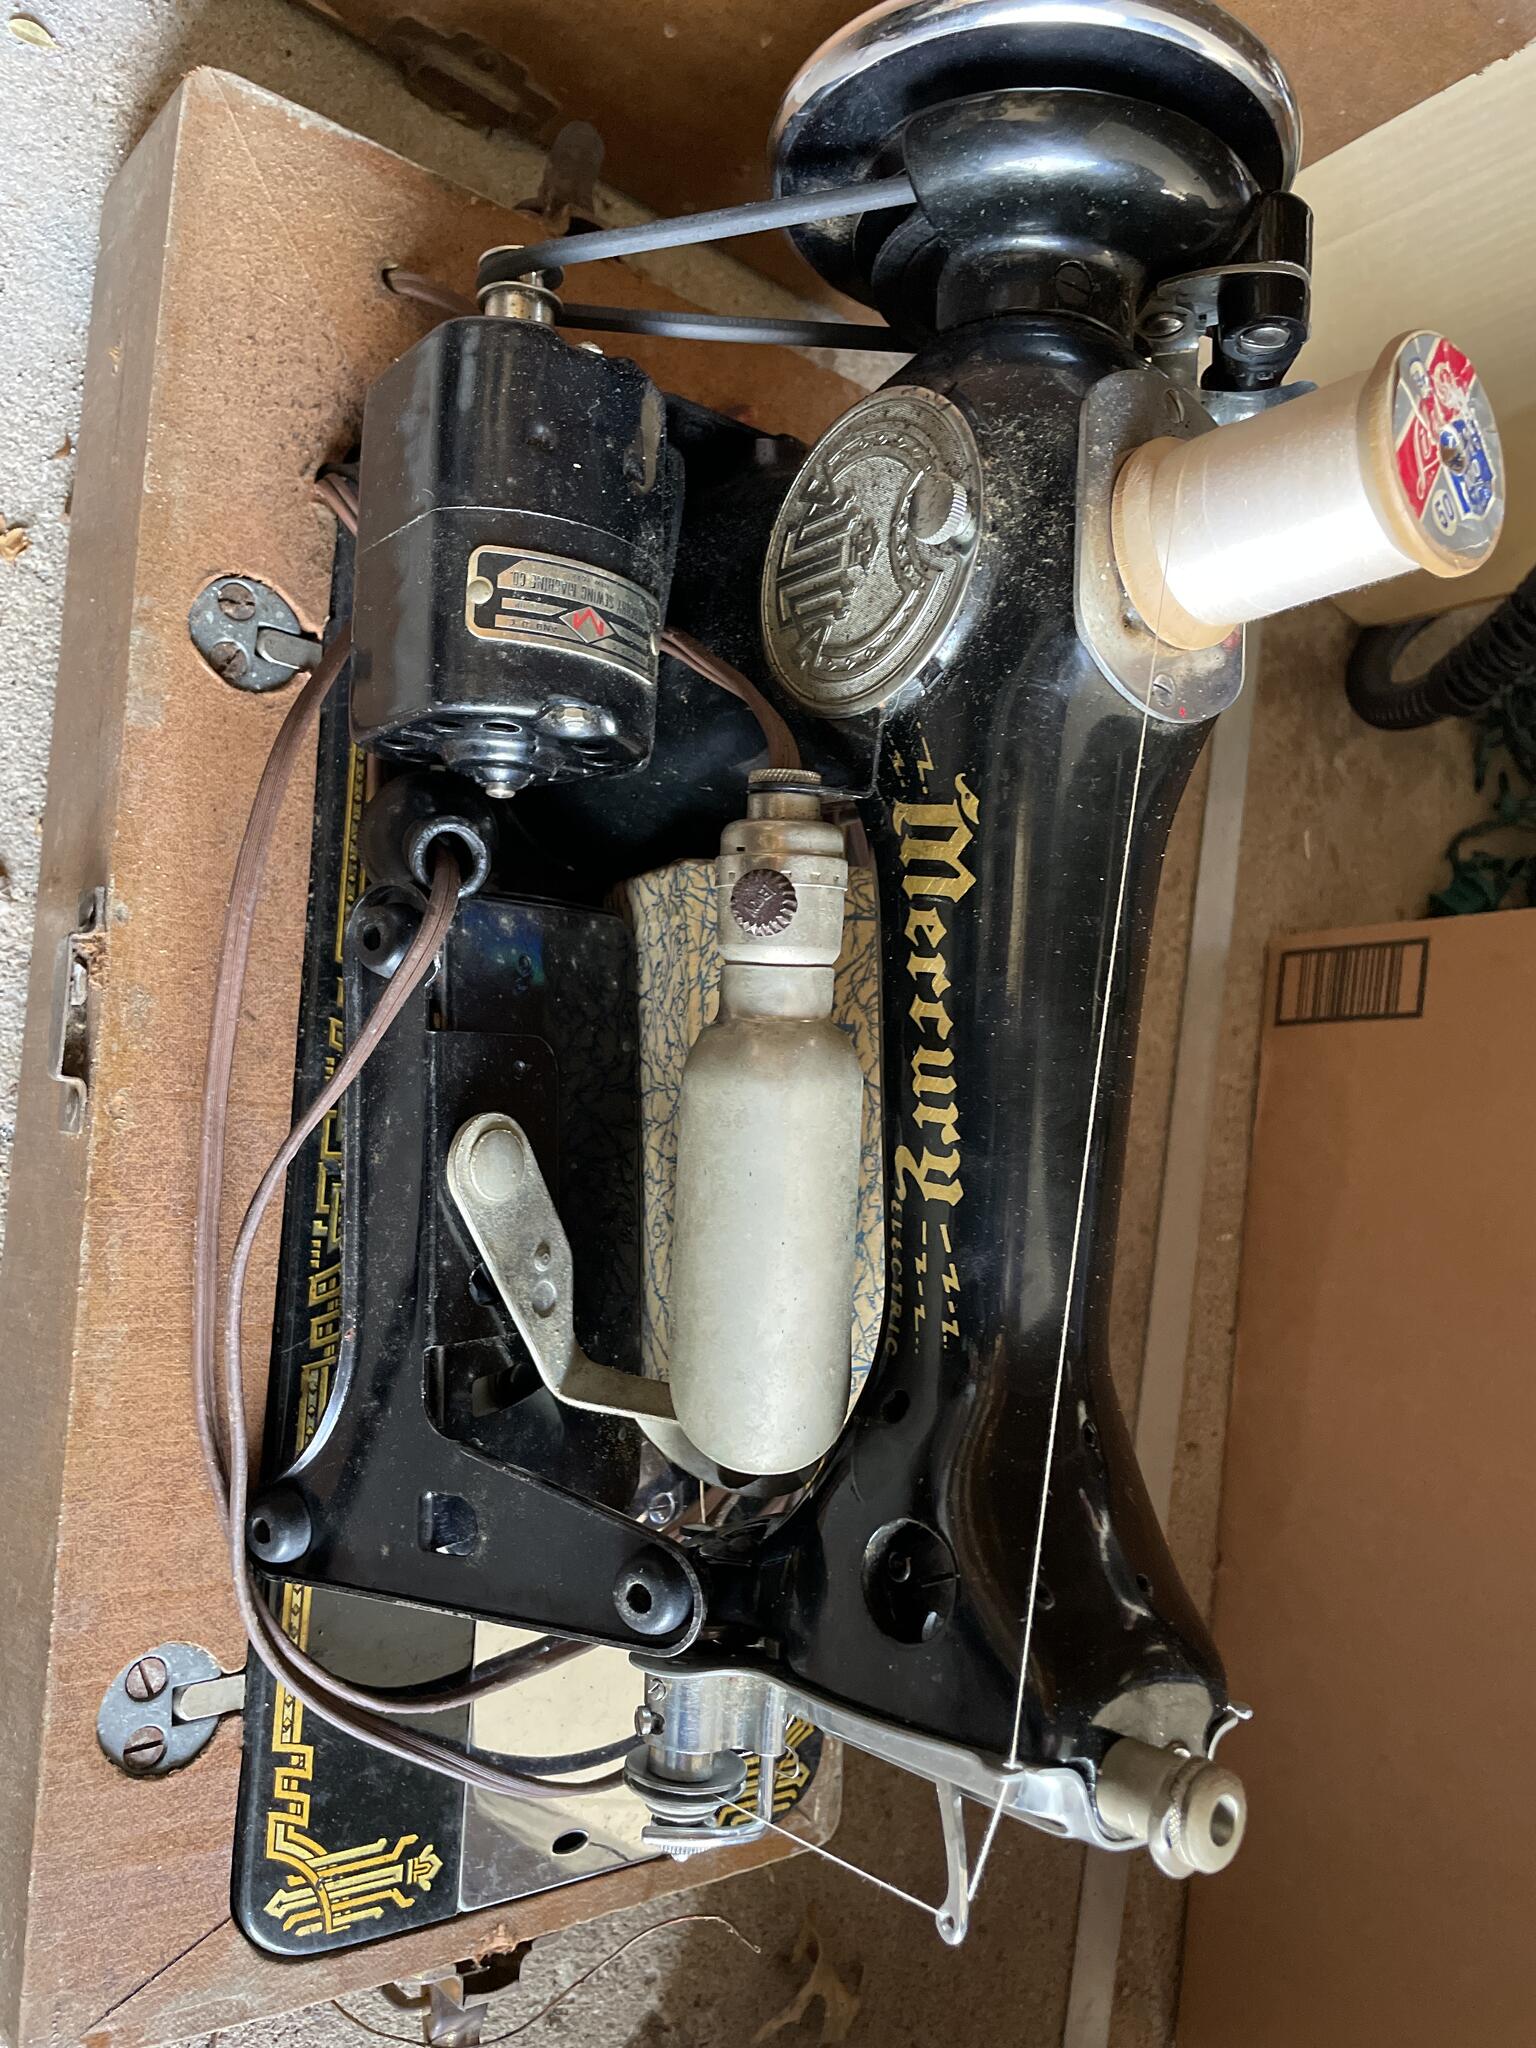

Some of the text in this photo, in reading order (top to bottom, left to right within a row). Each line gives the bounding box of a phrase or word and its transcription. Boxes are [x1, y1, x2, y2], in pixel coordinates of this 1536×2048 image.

[1434, 492, 1455, 529] 50
[531, 573, 578, 599] MACHINE
[581, 586, 615, 610] SEWING
[892, 772, 980, 1207] Mercury
[884, 1198, 903, 1357] ELECTRIC
